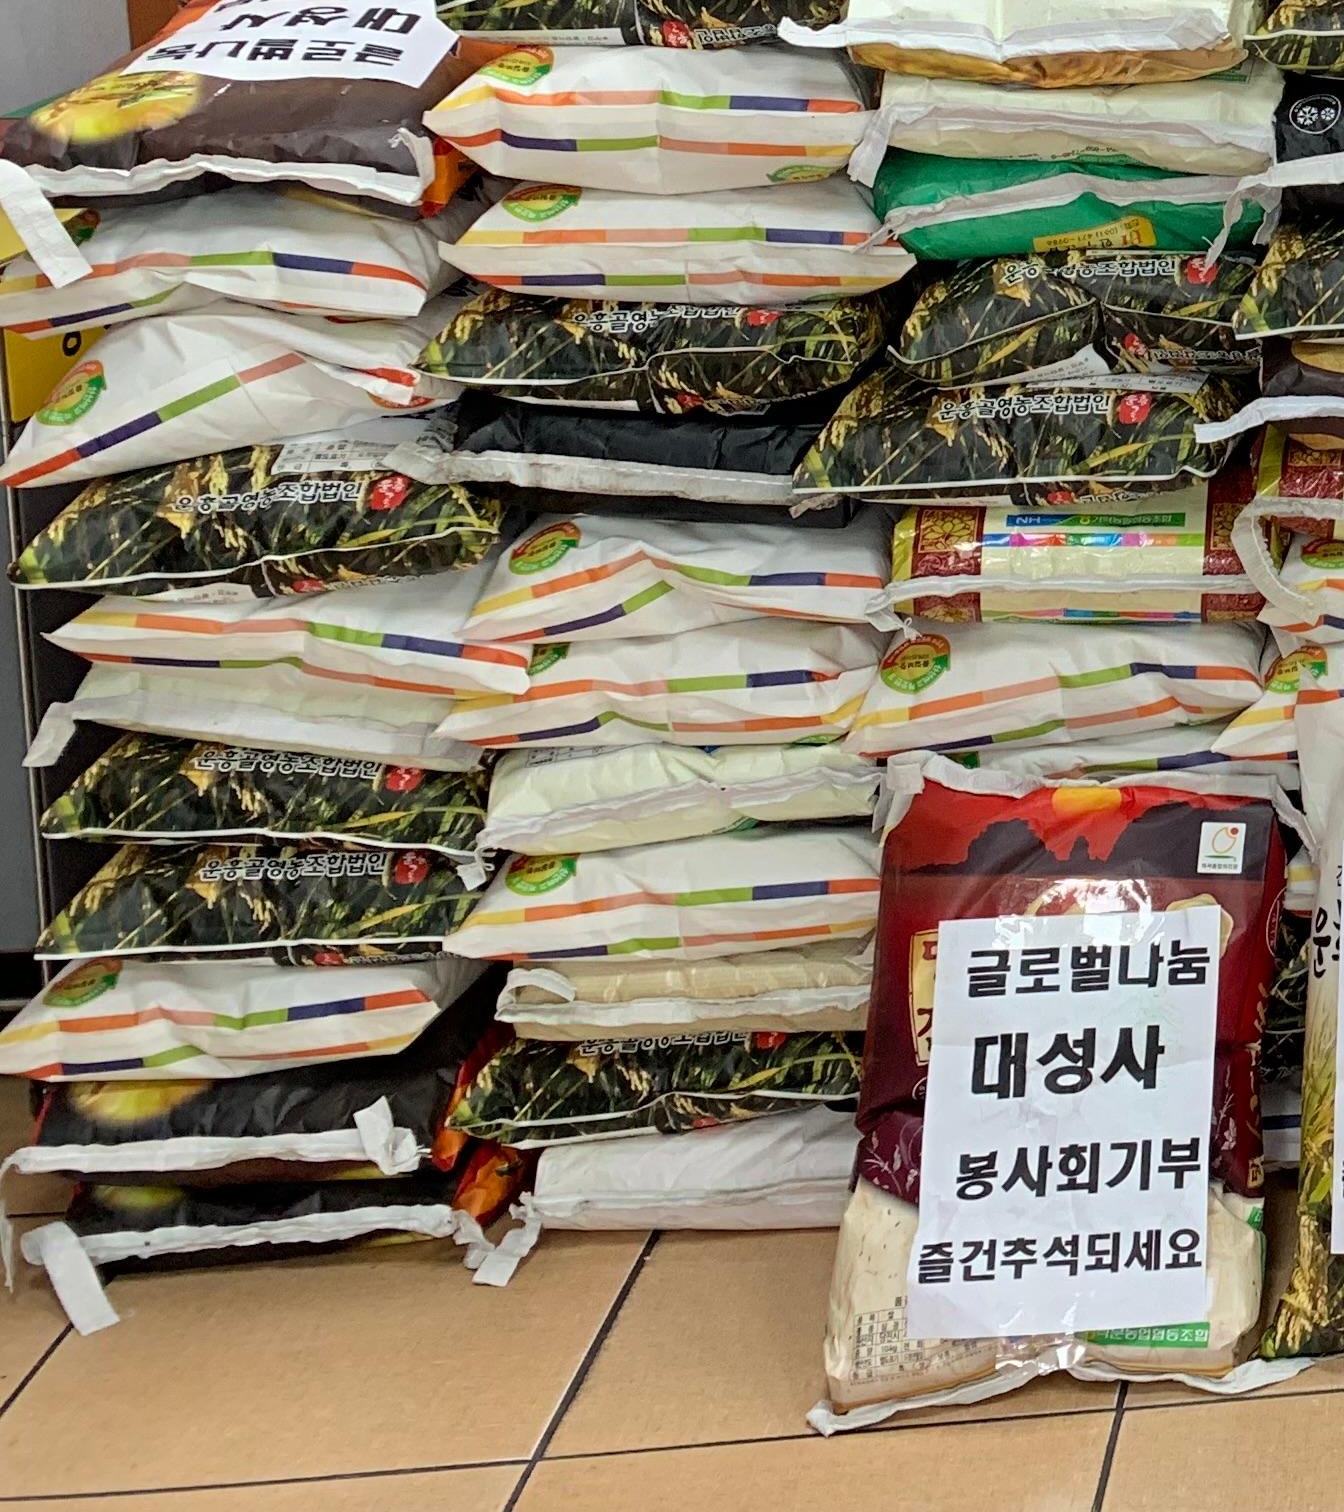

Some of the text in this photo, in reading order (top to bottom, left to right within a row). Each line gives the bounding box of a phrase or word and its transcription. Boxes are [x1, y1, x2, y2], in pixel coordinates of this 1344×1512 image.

[967, 939, 1211, 998] 글로벌나눔
[971, 1025, 1166, 1102] 대성사
[955, 1138, 1202, 1200] 봉사회기부
[918, 1228, 1203, 1286] 즐건추석되세요
